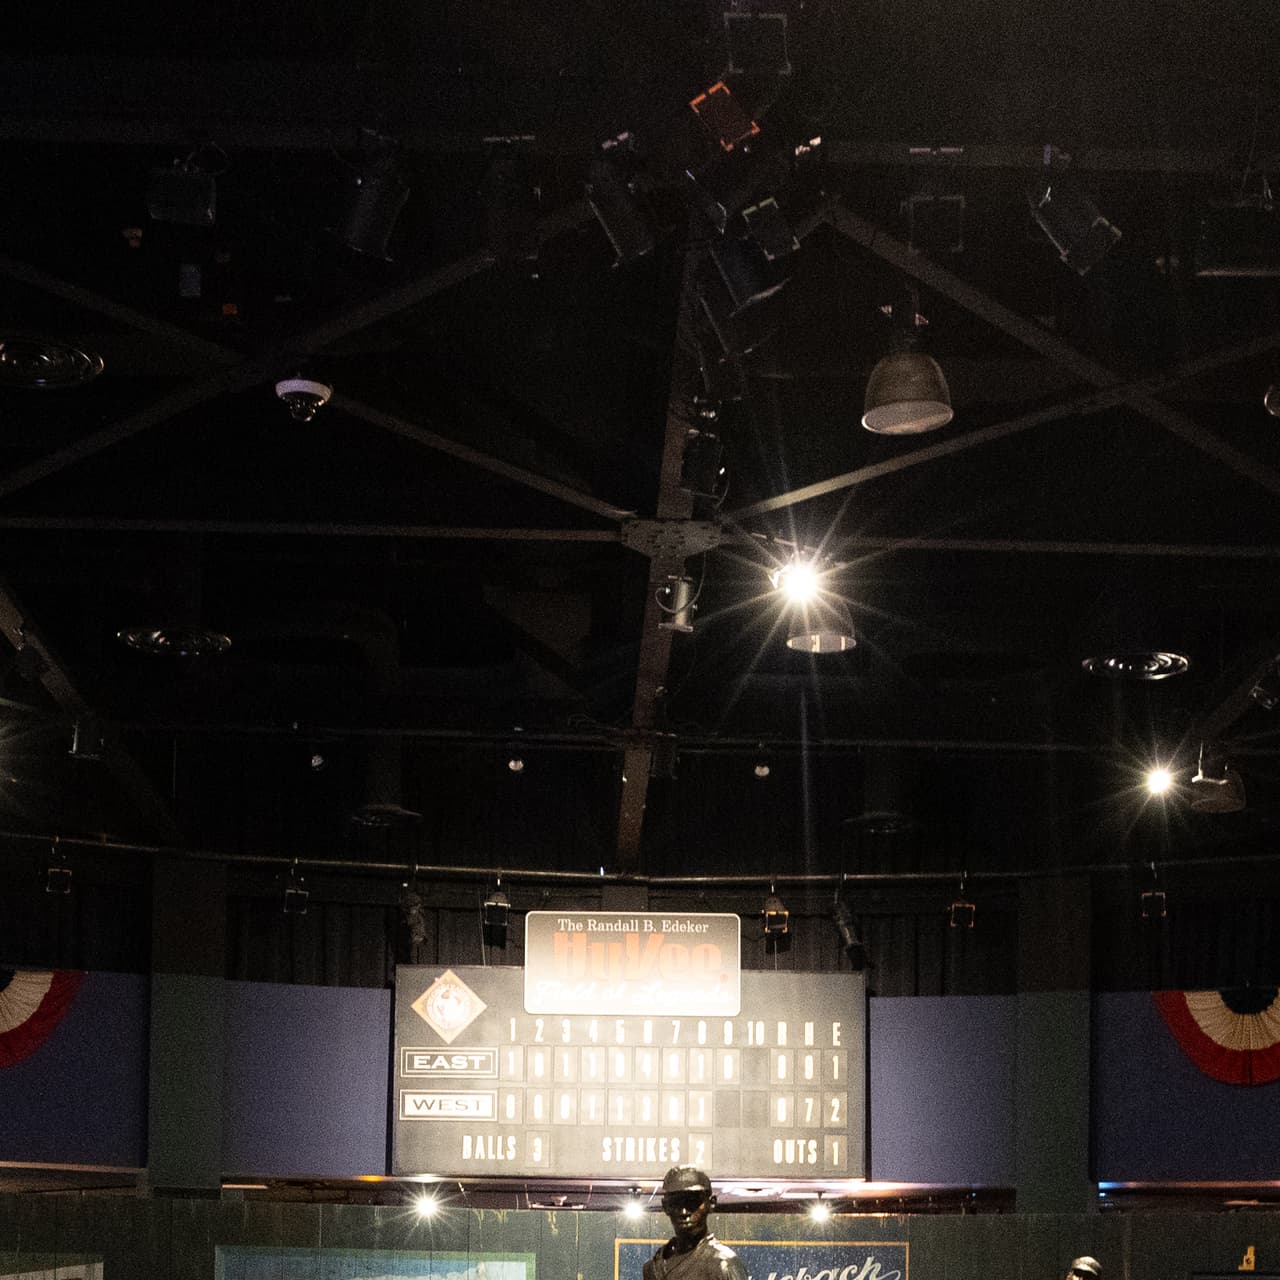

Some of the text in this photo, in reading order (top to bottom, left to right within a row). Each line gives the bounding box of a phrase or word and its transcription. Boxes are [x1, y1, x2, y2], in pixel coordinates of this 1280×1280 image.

[557, 918, 709, 933] The Randall B. Edeker
[509, 1017, 516, 1042] 1
[534, 1018, 544, 1042] 2
[562, 1018, 570, 1043] 3
[588, 1019, 598, 1043] 4
[616, 1019, 624, 1044] 5
[672, 1020, 680, 1044] 7
[724, 1020, 733, 1046] 9
[748, 1020, 765, 1046] 10
[778, 1021, 787, 1046] R
[804, 1022, 814, 1046] H
[832, 1022, 840, 1046] E
[413, 1055, 486, 1070] EAST
[508, 1050, 514, 1076] 1
[562, 1053, 570, 1078] 1
[832, 1056, 838, 1080] 1
[412, 1099, 482, 1111] WEST
[698, 1096, 705, 1122] 1
[804, 1098, 814, 1122] 7
[830, 1098, 840, 1122] 2
[462, 1135, 839, 1165] BALLS 3 STRIKES 2 OUTS 1
